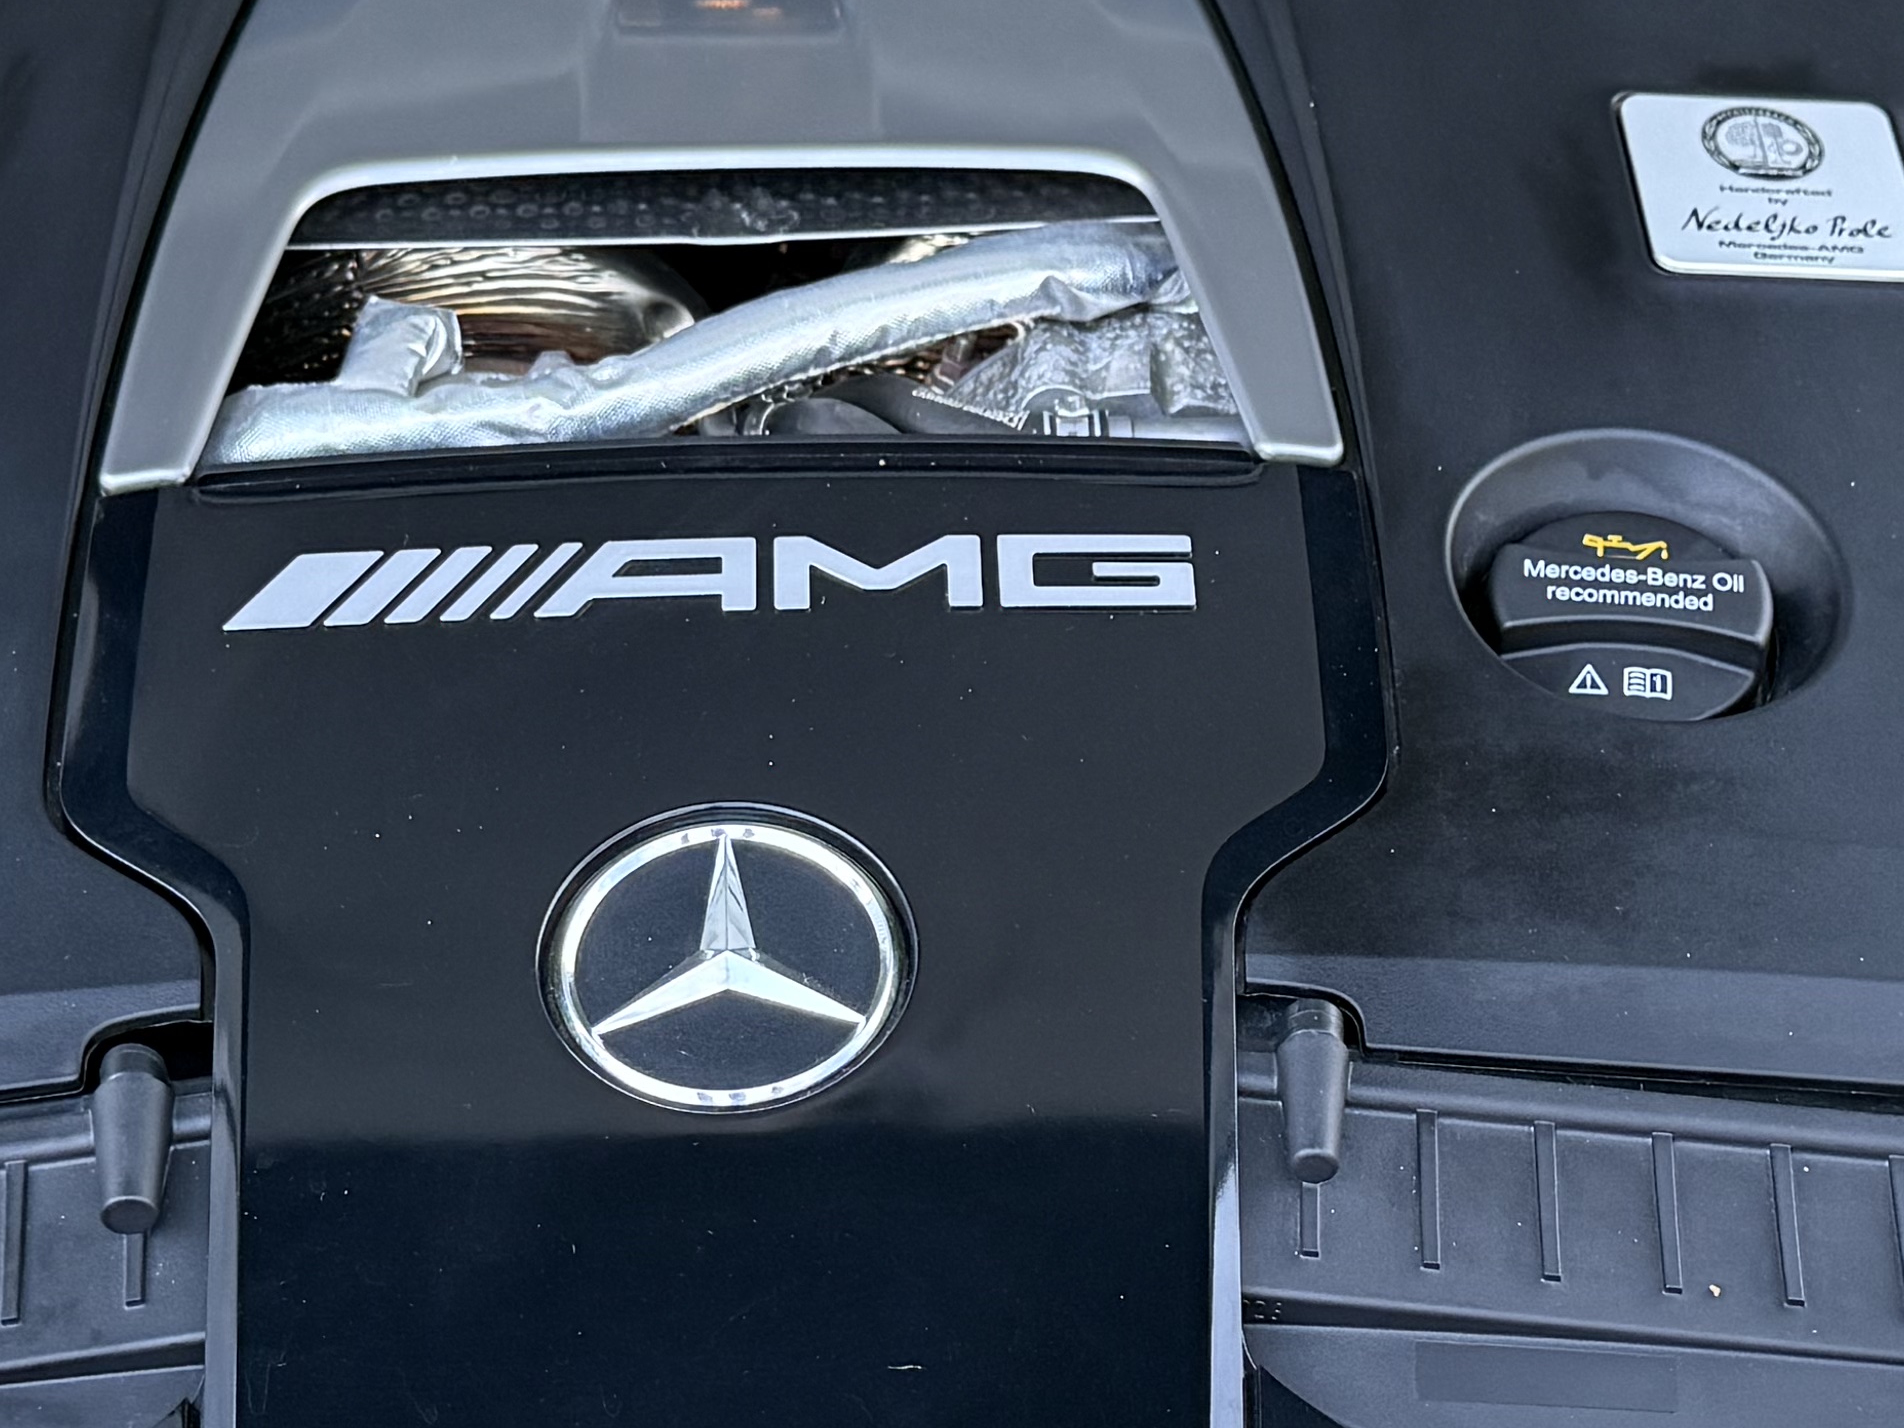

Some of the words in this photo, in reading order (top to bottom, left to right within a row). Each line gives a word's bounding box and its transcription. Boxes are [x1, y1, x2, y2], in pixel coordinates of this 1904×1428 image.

[536, 533, 1197, 620] AMG
[1523, 558, 1707, 589] Mercedes-Benz
[1712, 571, 1745, 593] Oil
[1546, 584, 1714, 612] recommended
